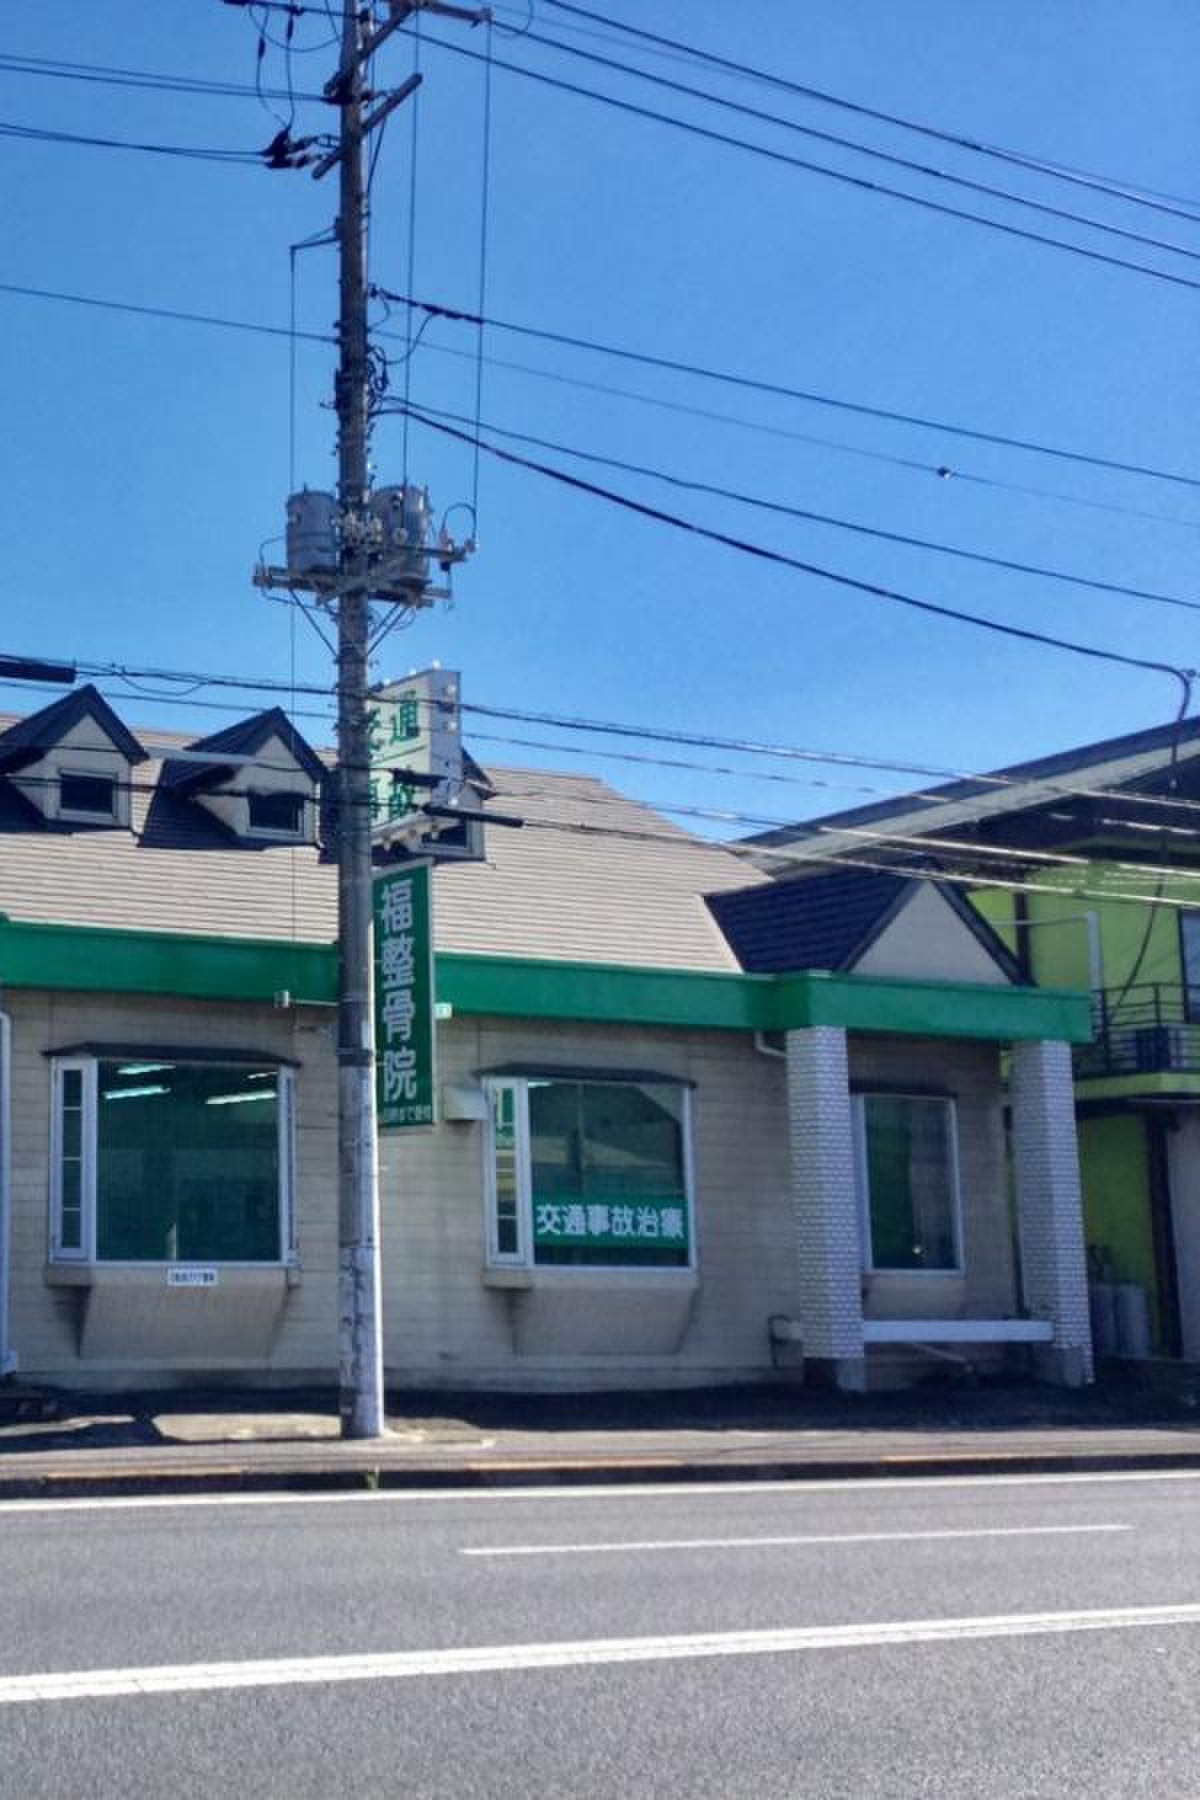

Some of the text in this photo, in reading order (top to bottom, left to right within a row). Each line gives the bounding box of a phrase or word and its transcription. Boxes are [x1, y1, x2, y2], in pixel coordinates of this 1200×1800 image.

[381, 878, 417, 1102] 福整骨院
[536, 1204, 685, 1239] 交通事故治療
